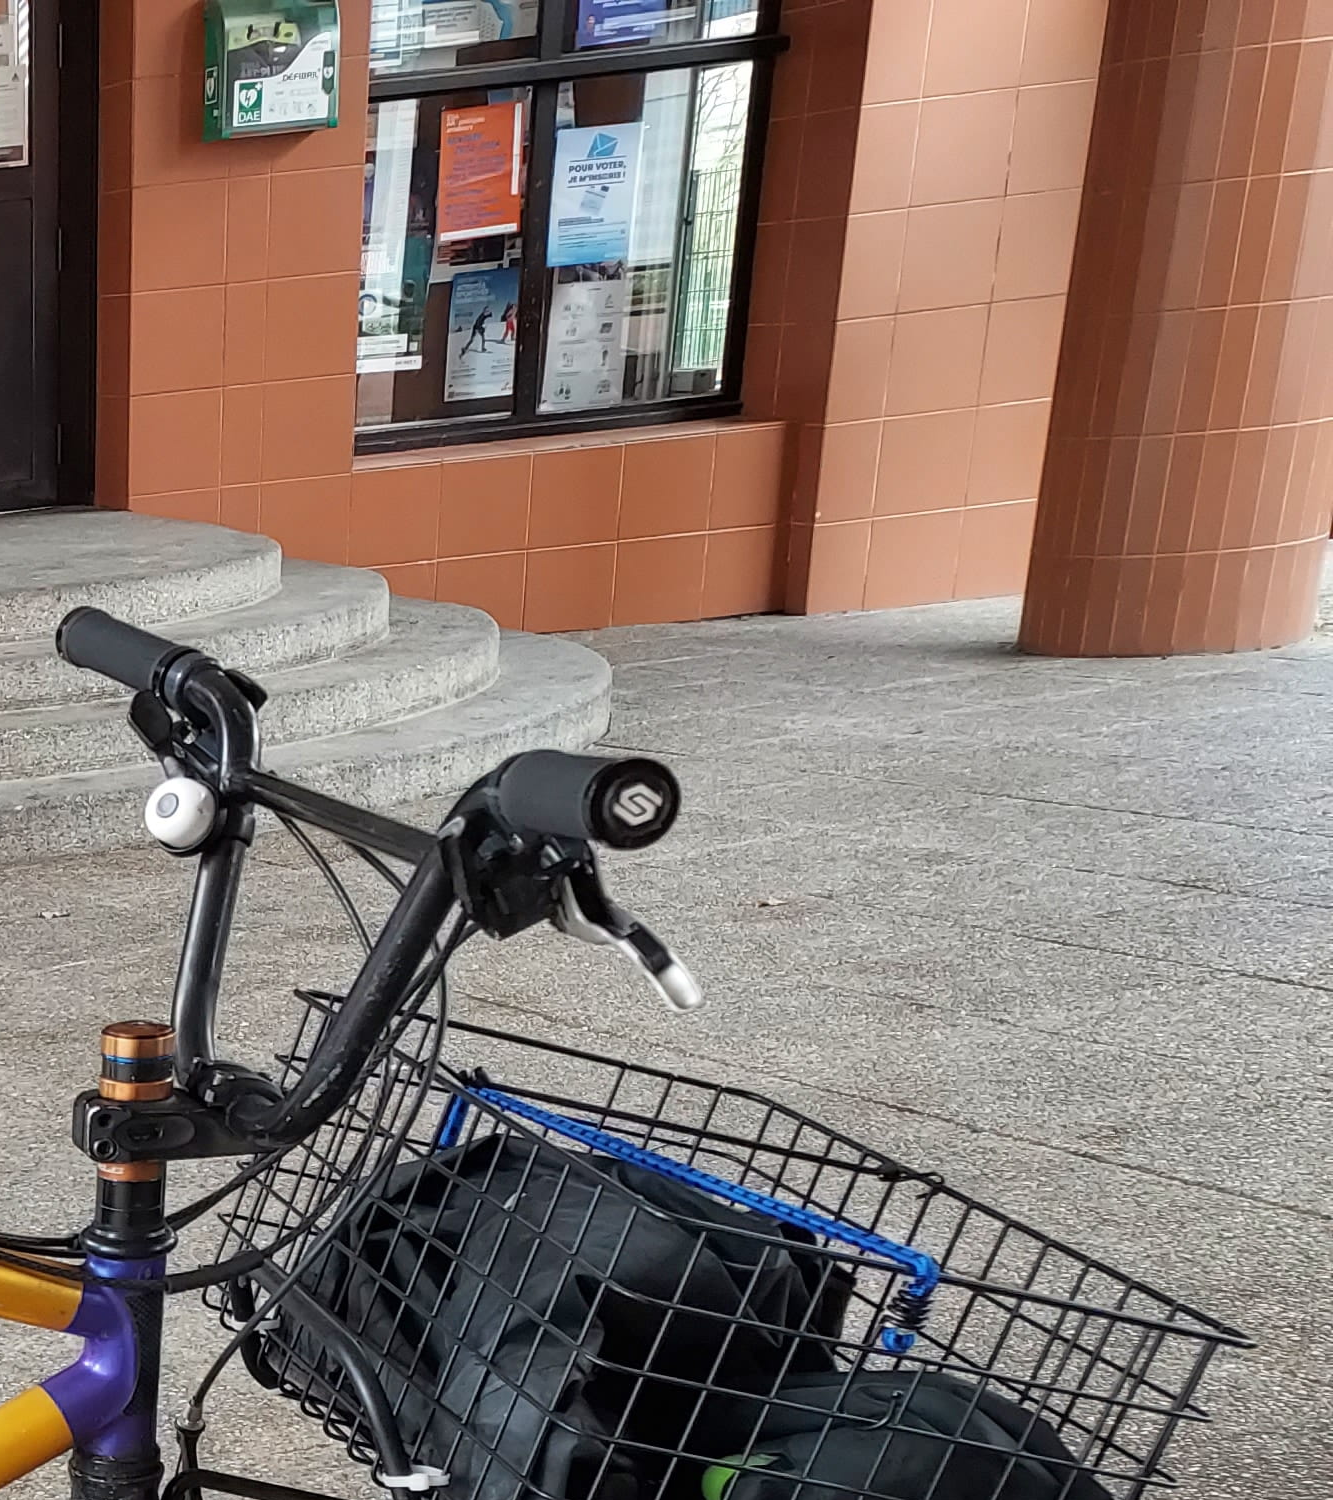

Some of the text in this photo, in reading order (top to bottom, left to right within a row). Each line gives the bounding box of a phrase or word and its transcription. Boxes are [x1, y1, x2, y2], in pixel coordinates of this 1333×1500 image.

[238, 111, 261, 122] DAE
[568, 160, 627, 174] POUR VOTER,
